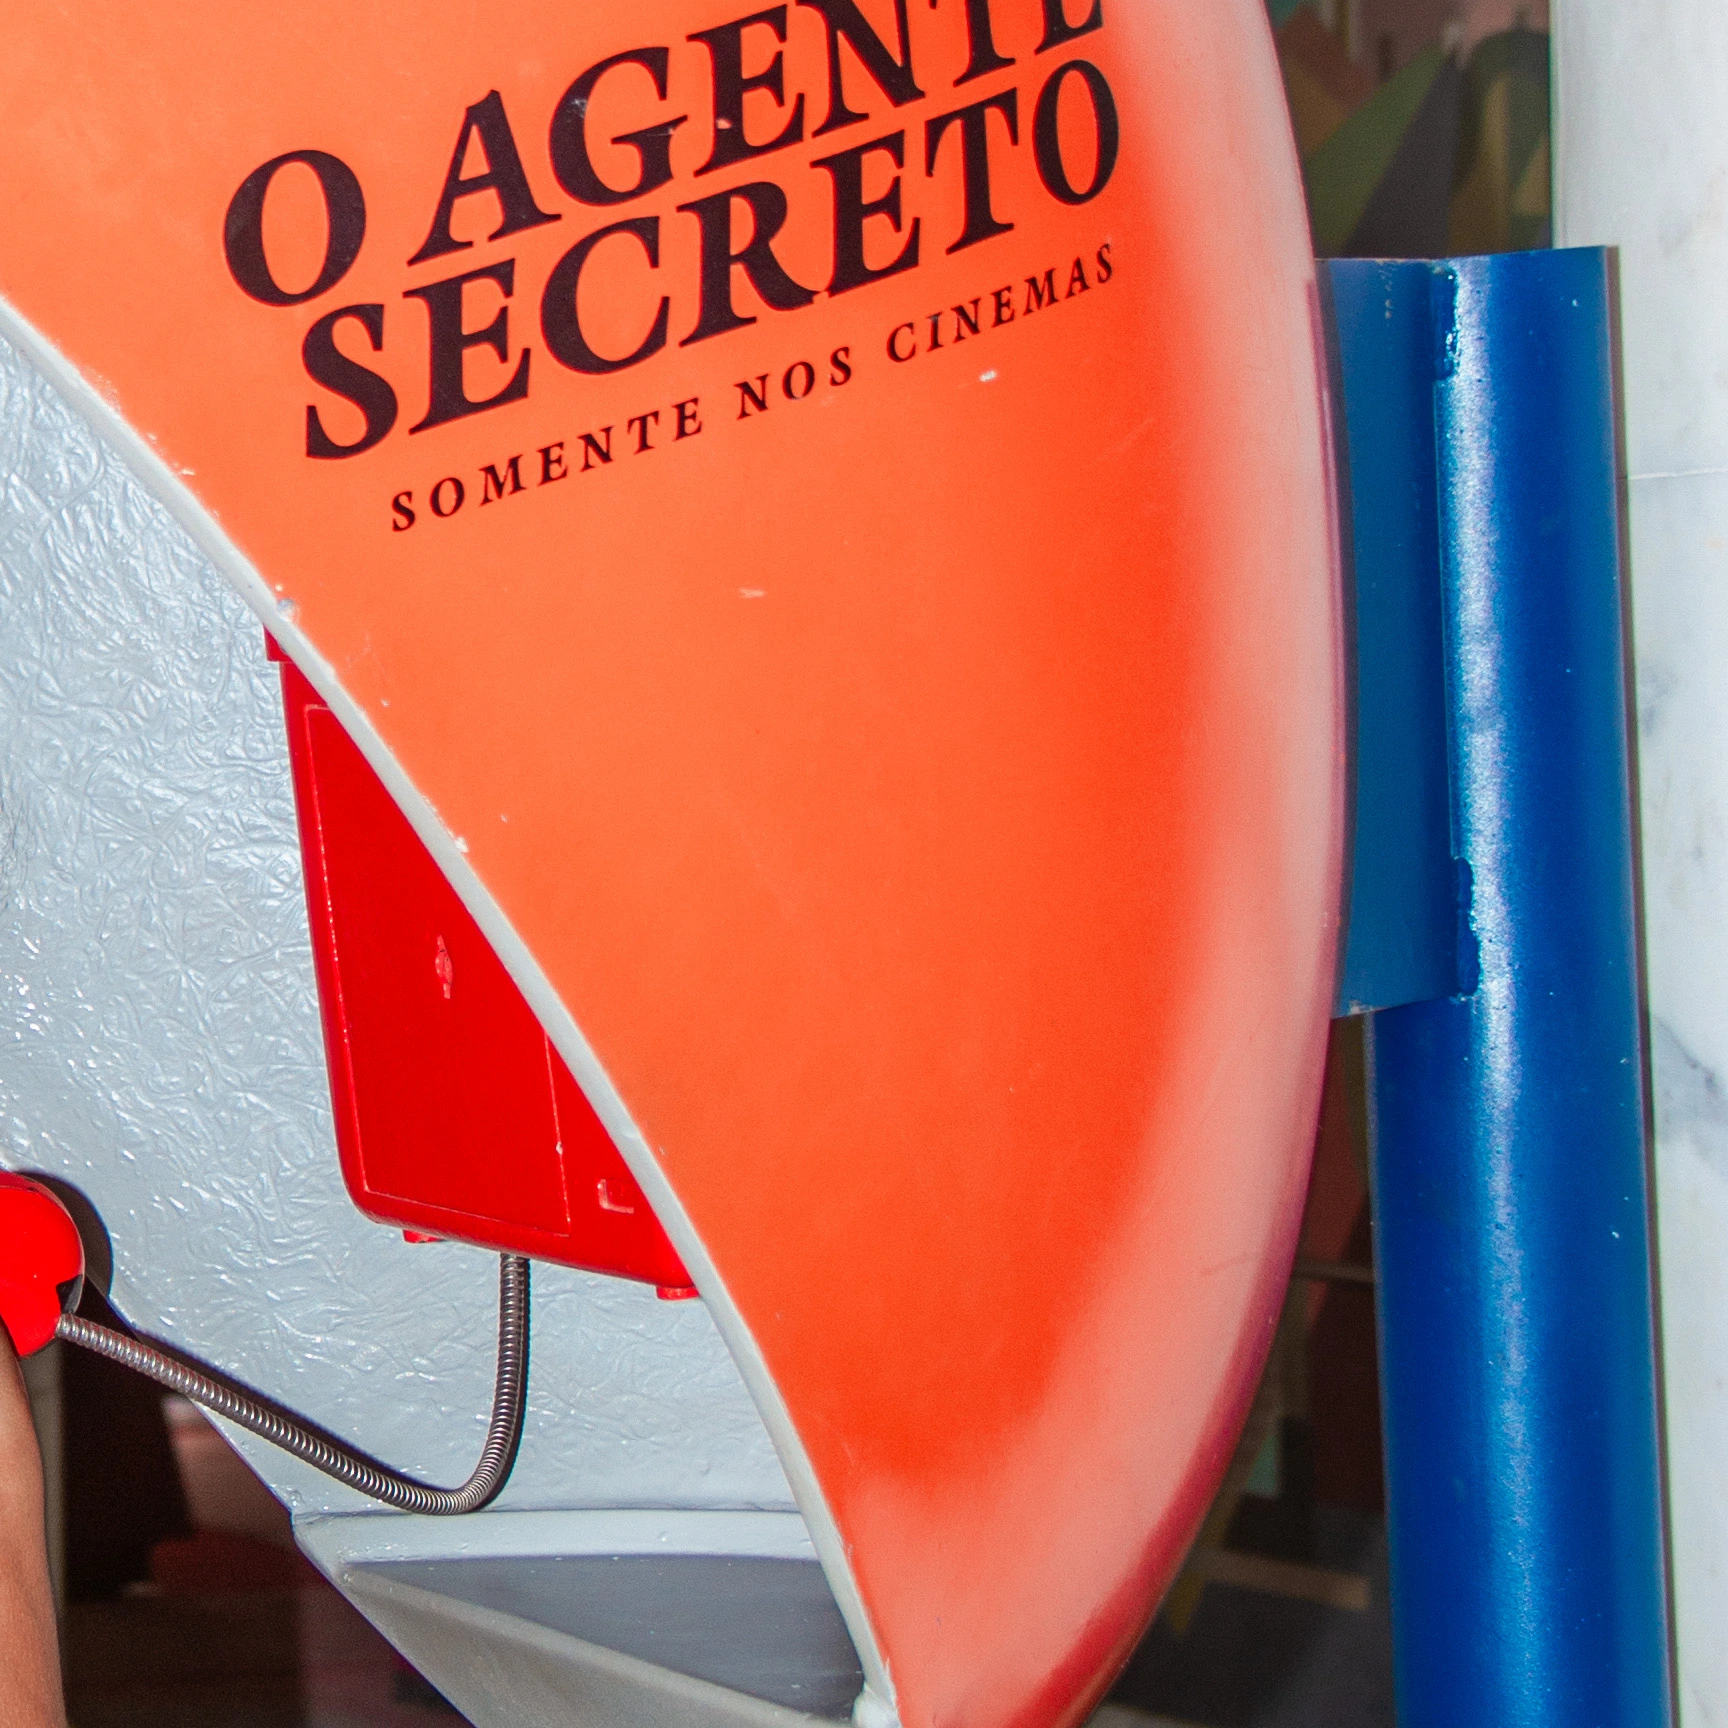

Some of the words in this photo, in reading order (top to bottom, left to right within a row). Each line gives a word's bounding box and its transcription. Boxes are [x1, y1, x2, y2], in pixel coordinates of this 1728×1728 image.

[223, 149, 367, 307] O
[301, 58, 1120, 459] SECRETO
[390, 398, 705, 533] SOMENTE
[735, 346, 854, 420] NOS
[885, 243, 1116, 363] CINEMAS
